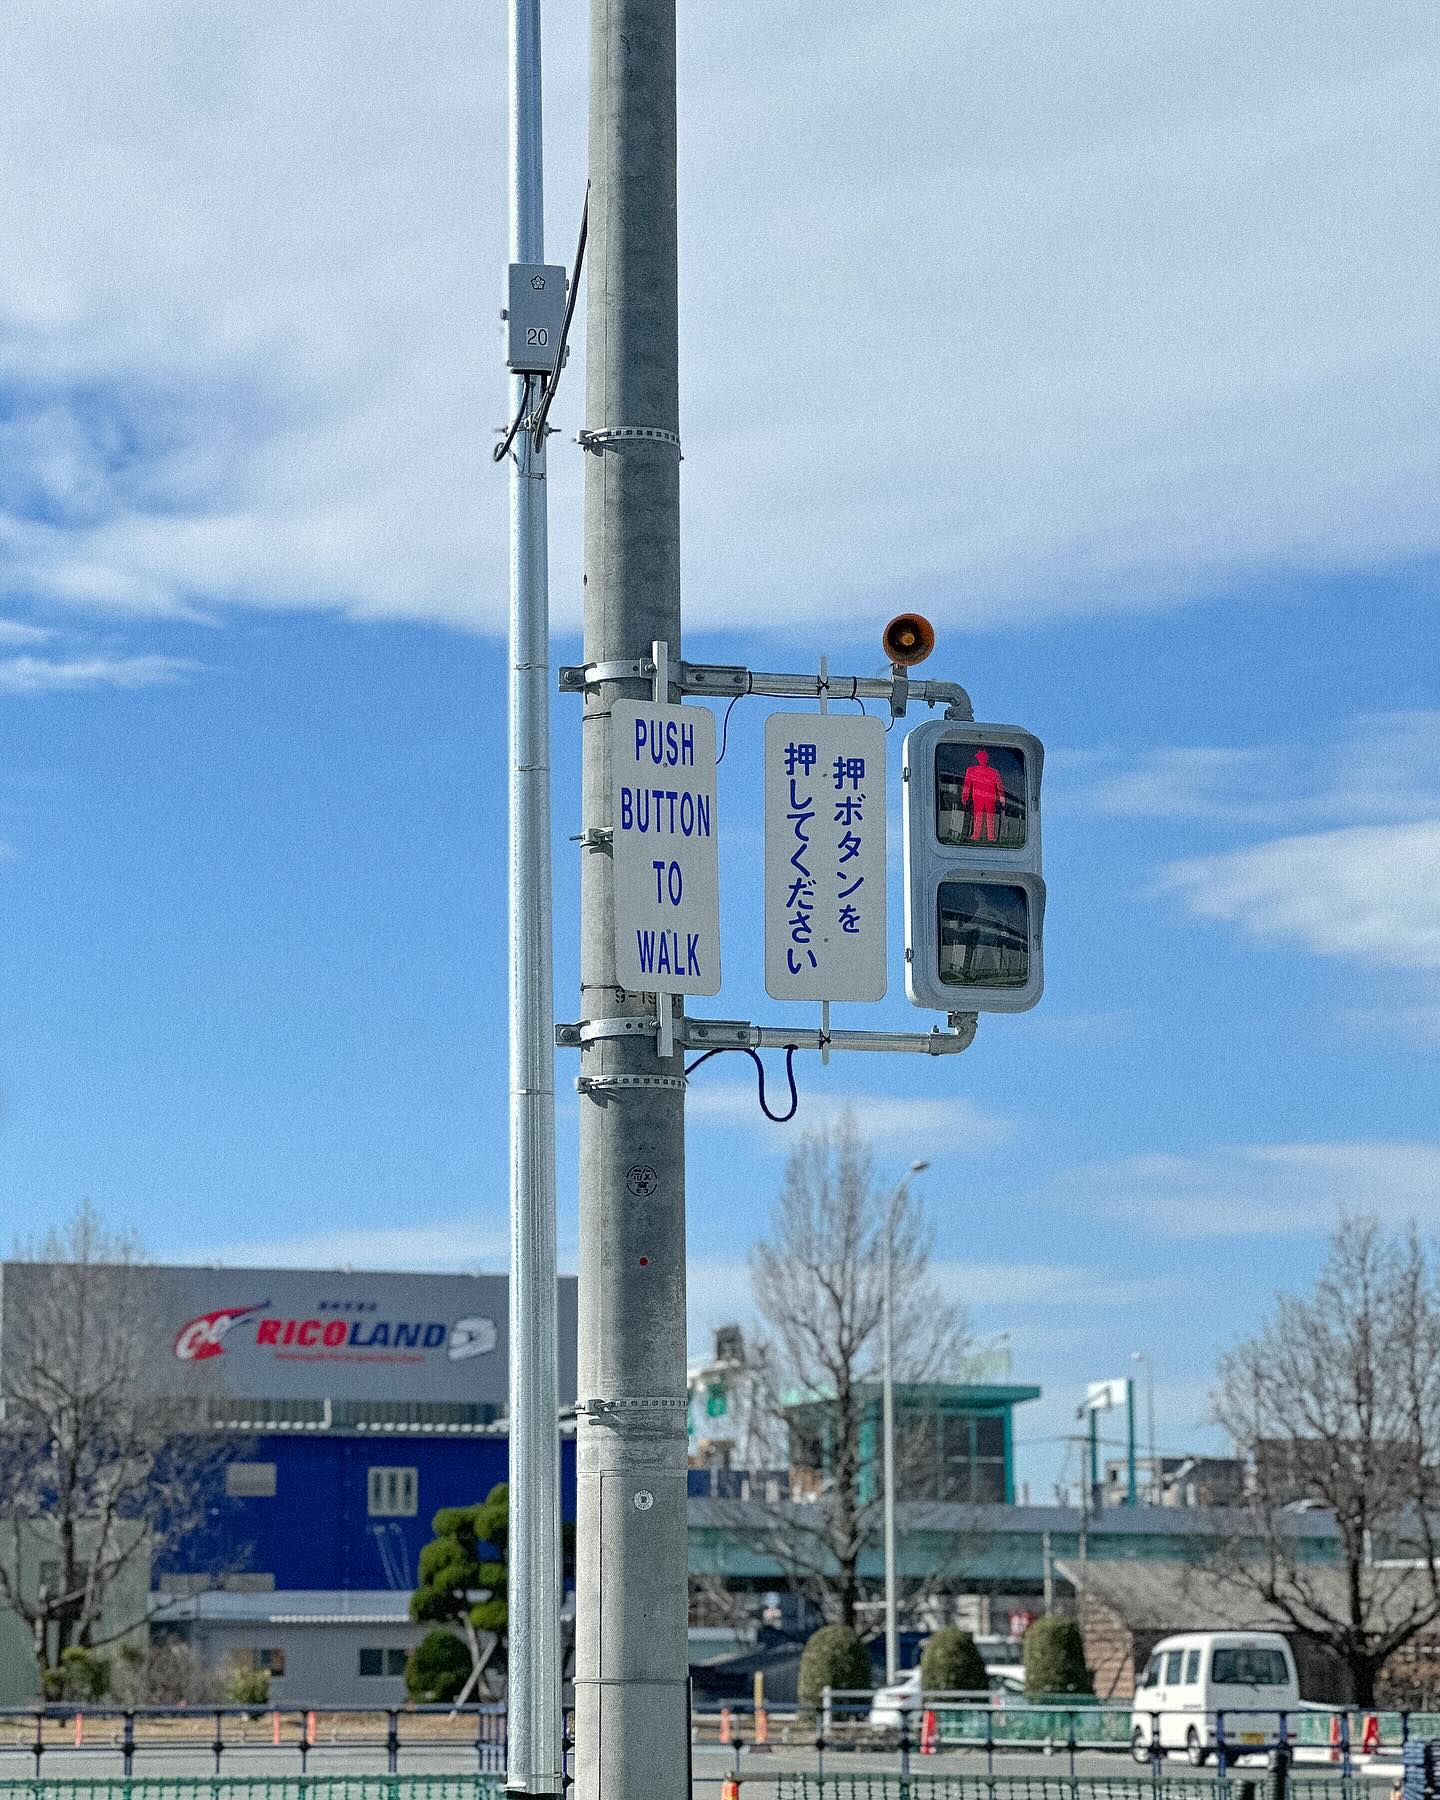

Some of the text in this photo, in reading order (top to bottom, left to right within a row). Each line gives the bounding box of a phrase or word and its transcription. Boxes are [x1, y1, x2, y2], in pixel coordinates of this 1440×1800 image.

[527, 328, 548, 345] 20
[635, 719, 694, 766] PUSH
[621, 787, 710, 837] BUTTON
[784, 742, 817, 974] 押してください
[833, 756, 866, 933] 押ボタンを
[653, 861, 682, 906] TO
[637, 930, 701, 976] WALK
[256, 1318, 447, 1349] RICOLAND
